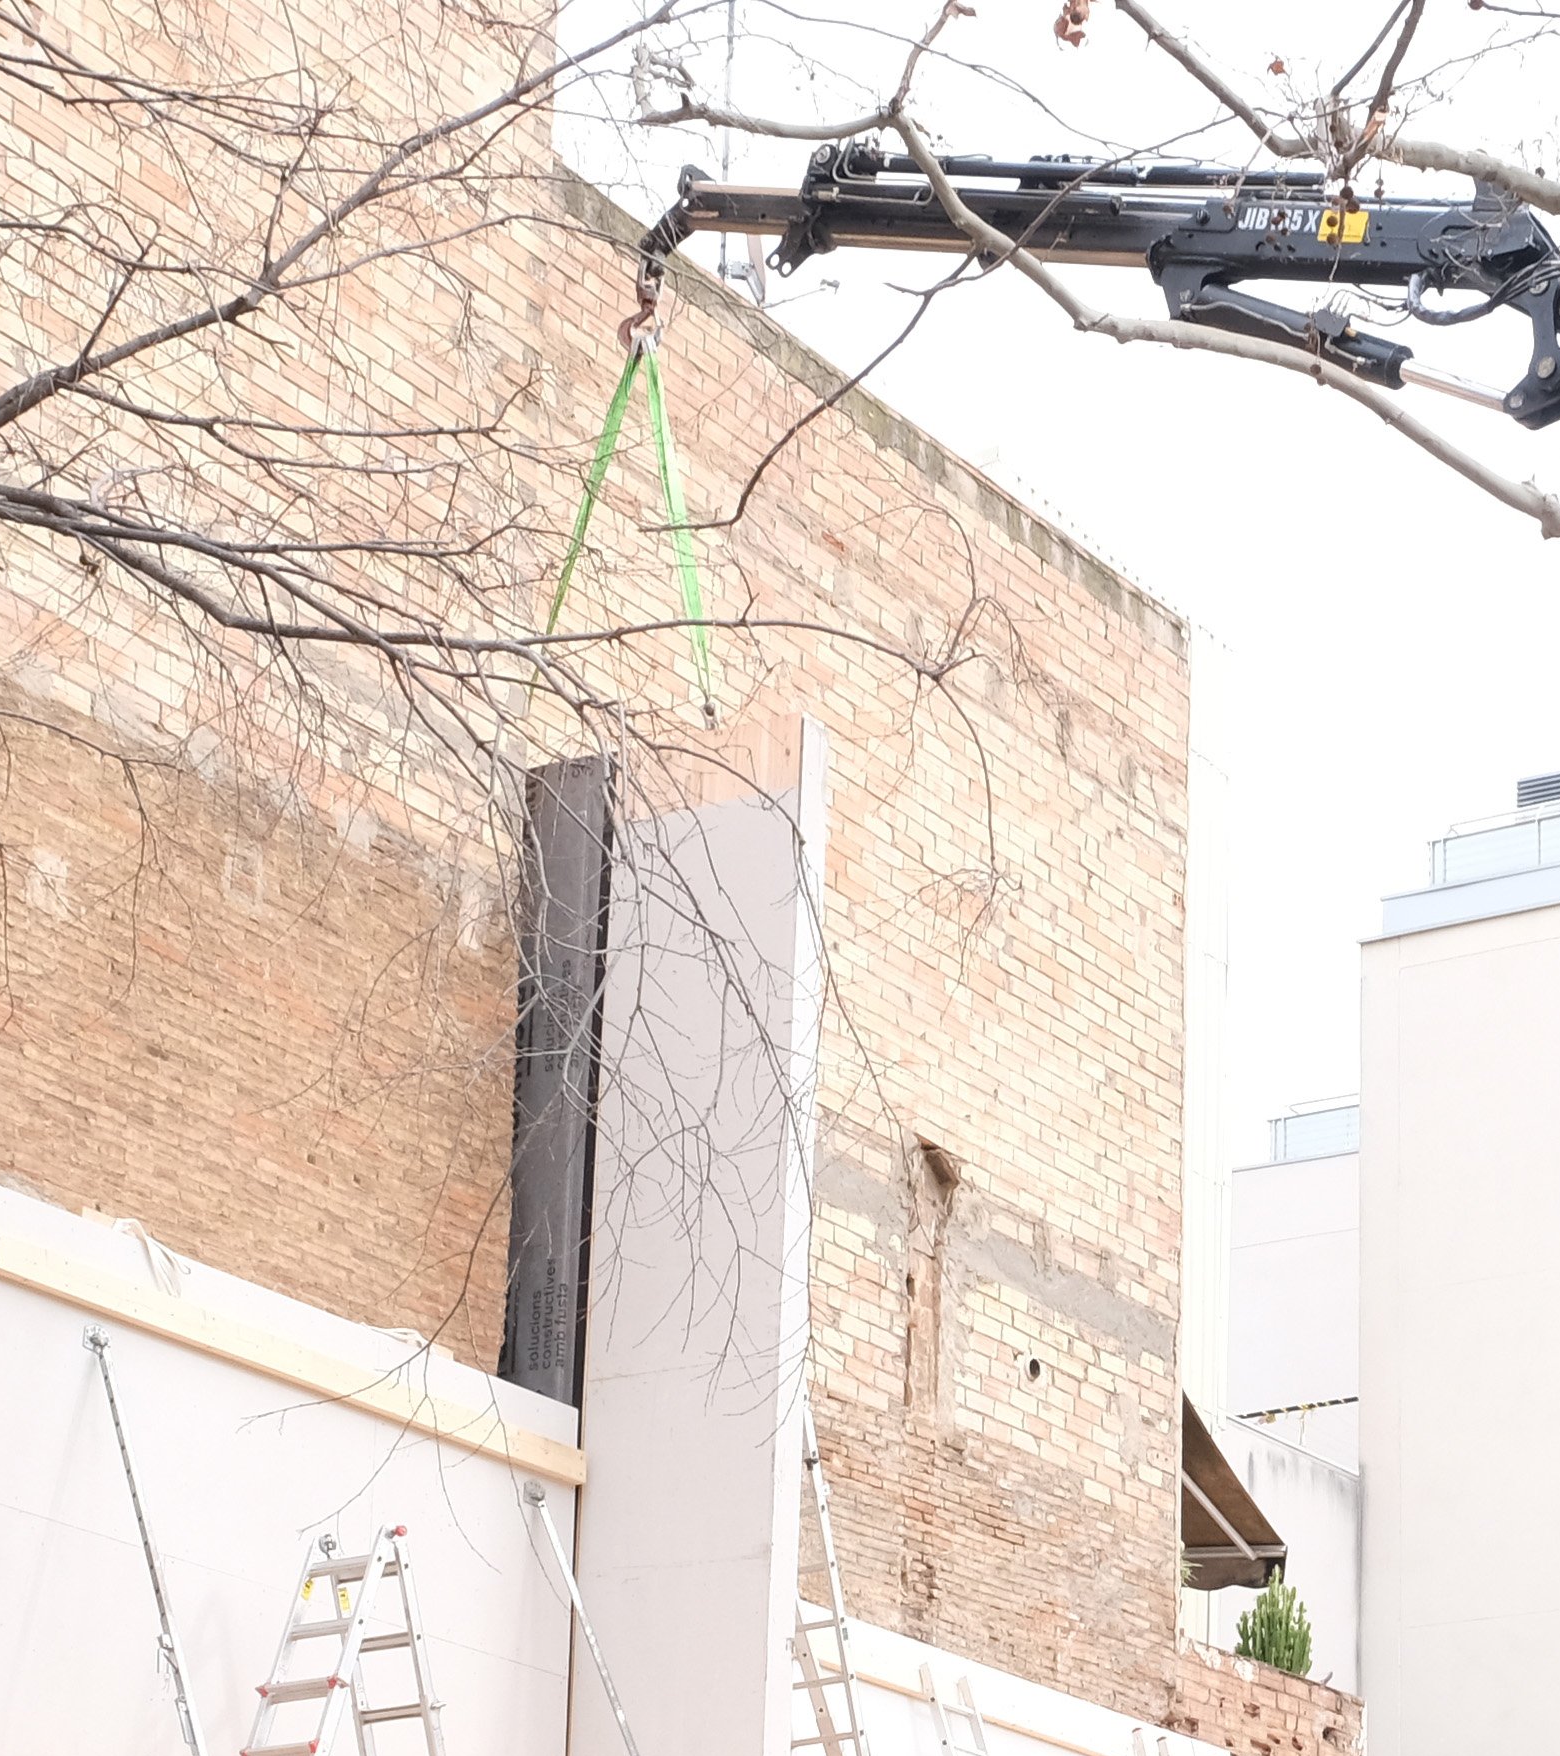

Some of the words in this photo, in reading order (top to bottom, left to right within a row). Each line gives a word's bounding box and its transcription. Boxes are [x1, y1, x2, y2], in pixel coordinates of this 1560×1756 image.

[529, 1290, 542, 1371] solucions
[542, 1257, 557, 1370] constructives
[555, 1282, 568, 1326] fusta
[554, 1331, 566, 1368] amb
